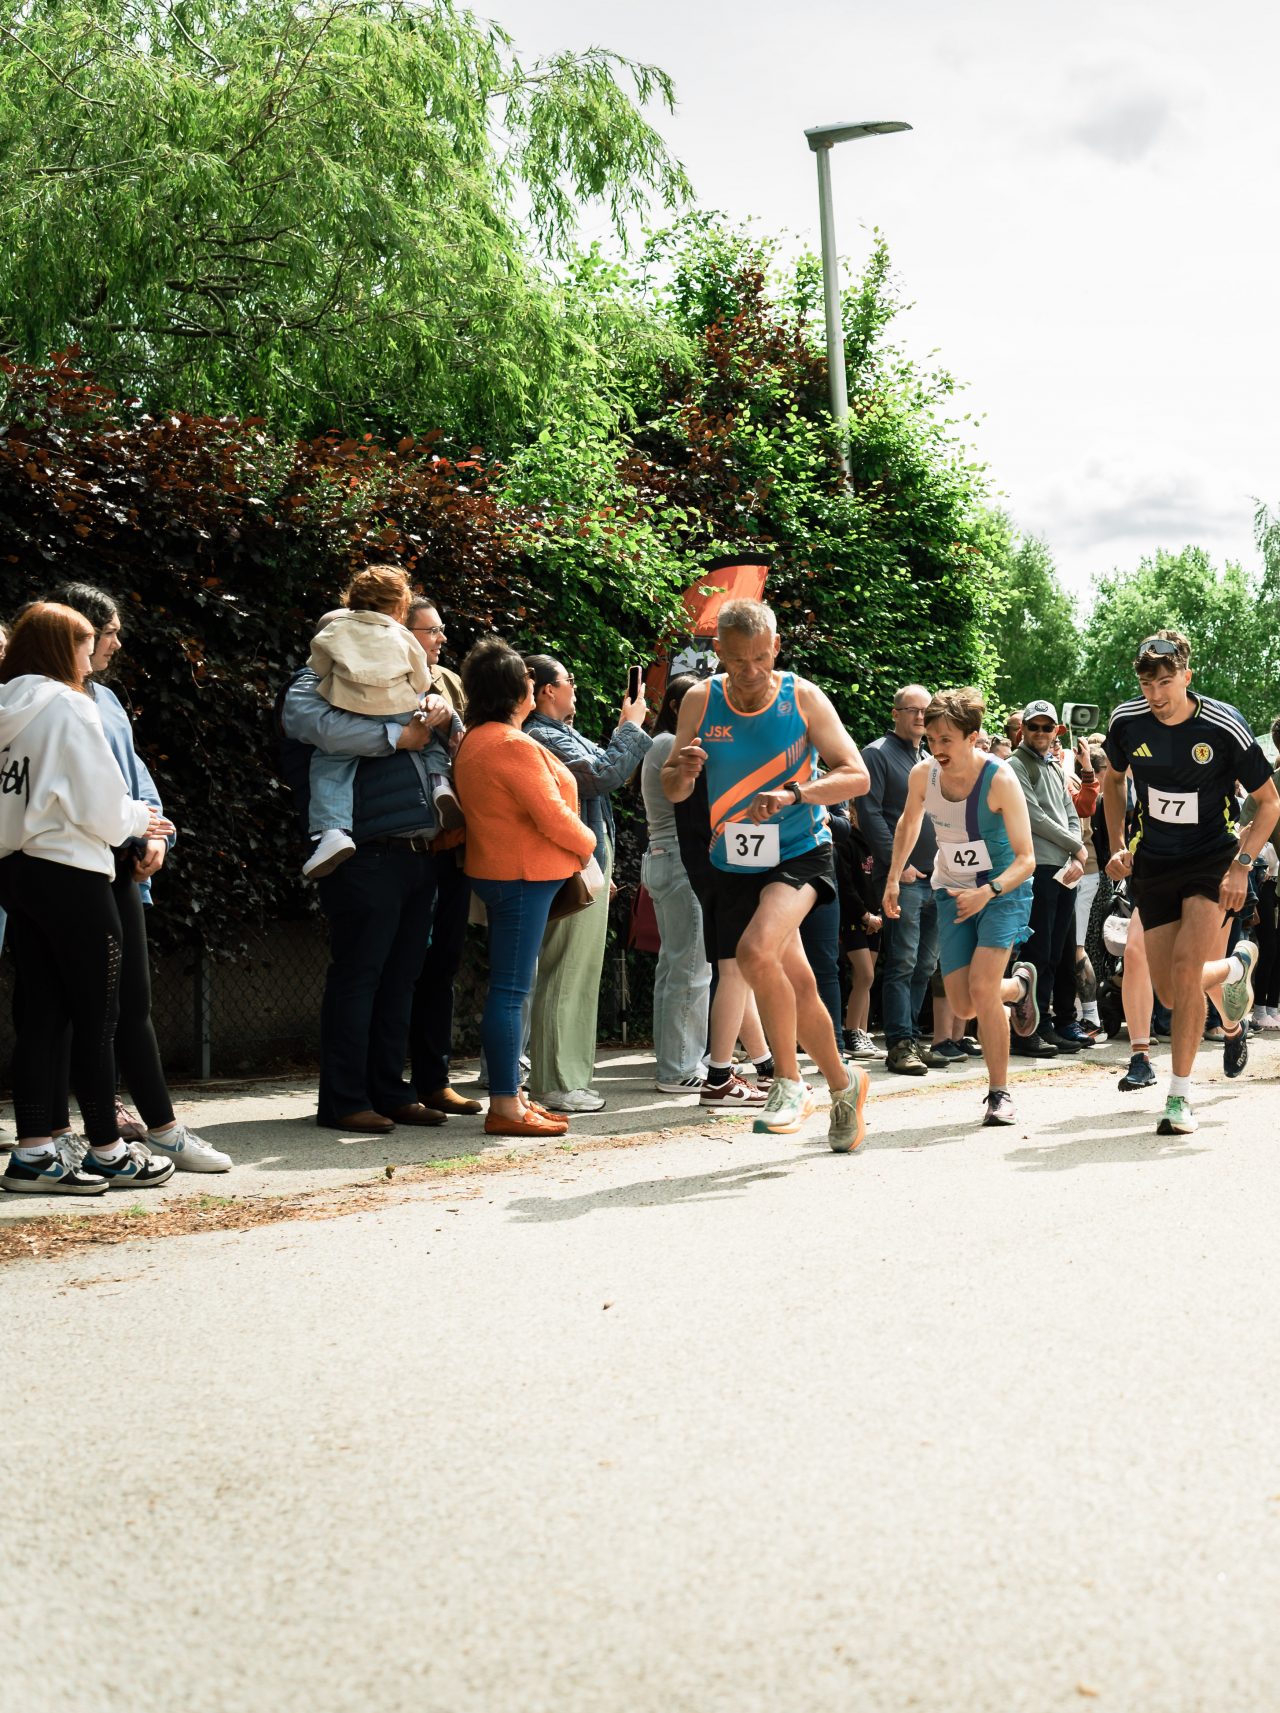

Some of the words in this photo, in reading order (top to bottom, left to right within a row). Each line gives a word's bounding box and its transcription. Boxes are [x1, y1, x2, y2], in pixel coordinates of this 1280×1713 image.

[705, 726, 732, 737] JSK
[1158, 798, 1186, 816] 77
[736, 834, 765, 857] 37
[954, 850, 980, 867] 42
